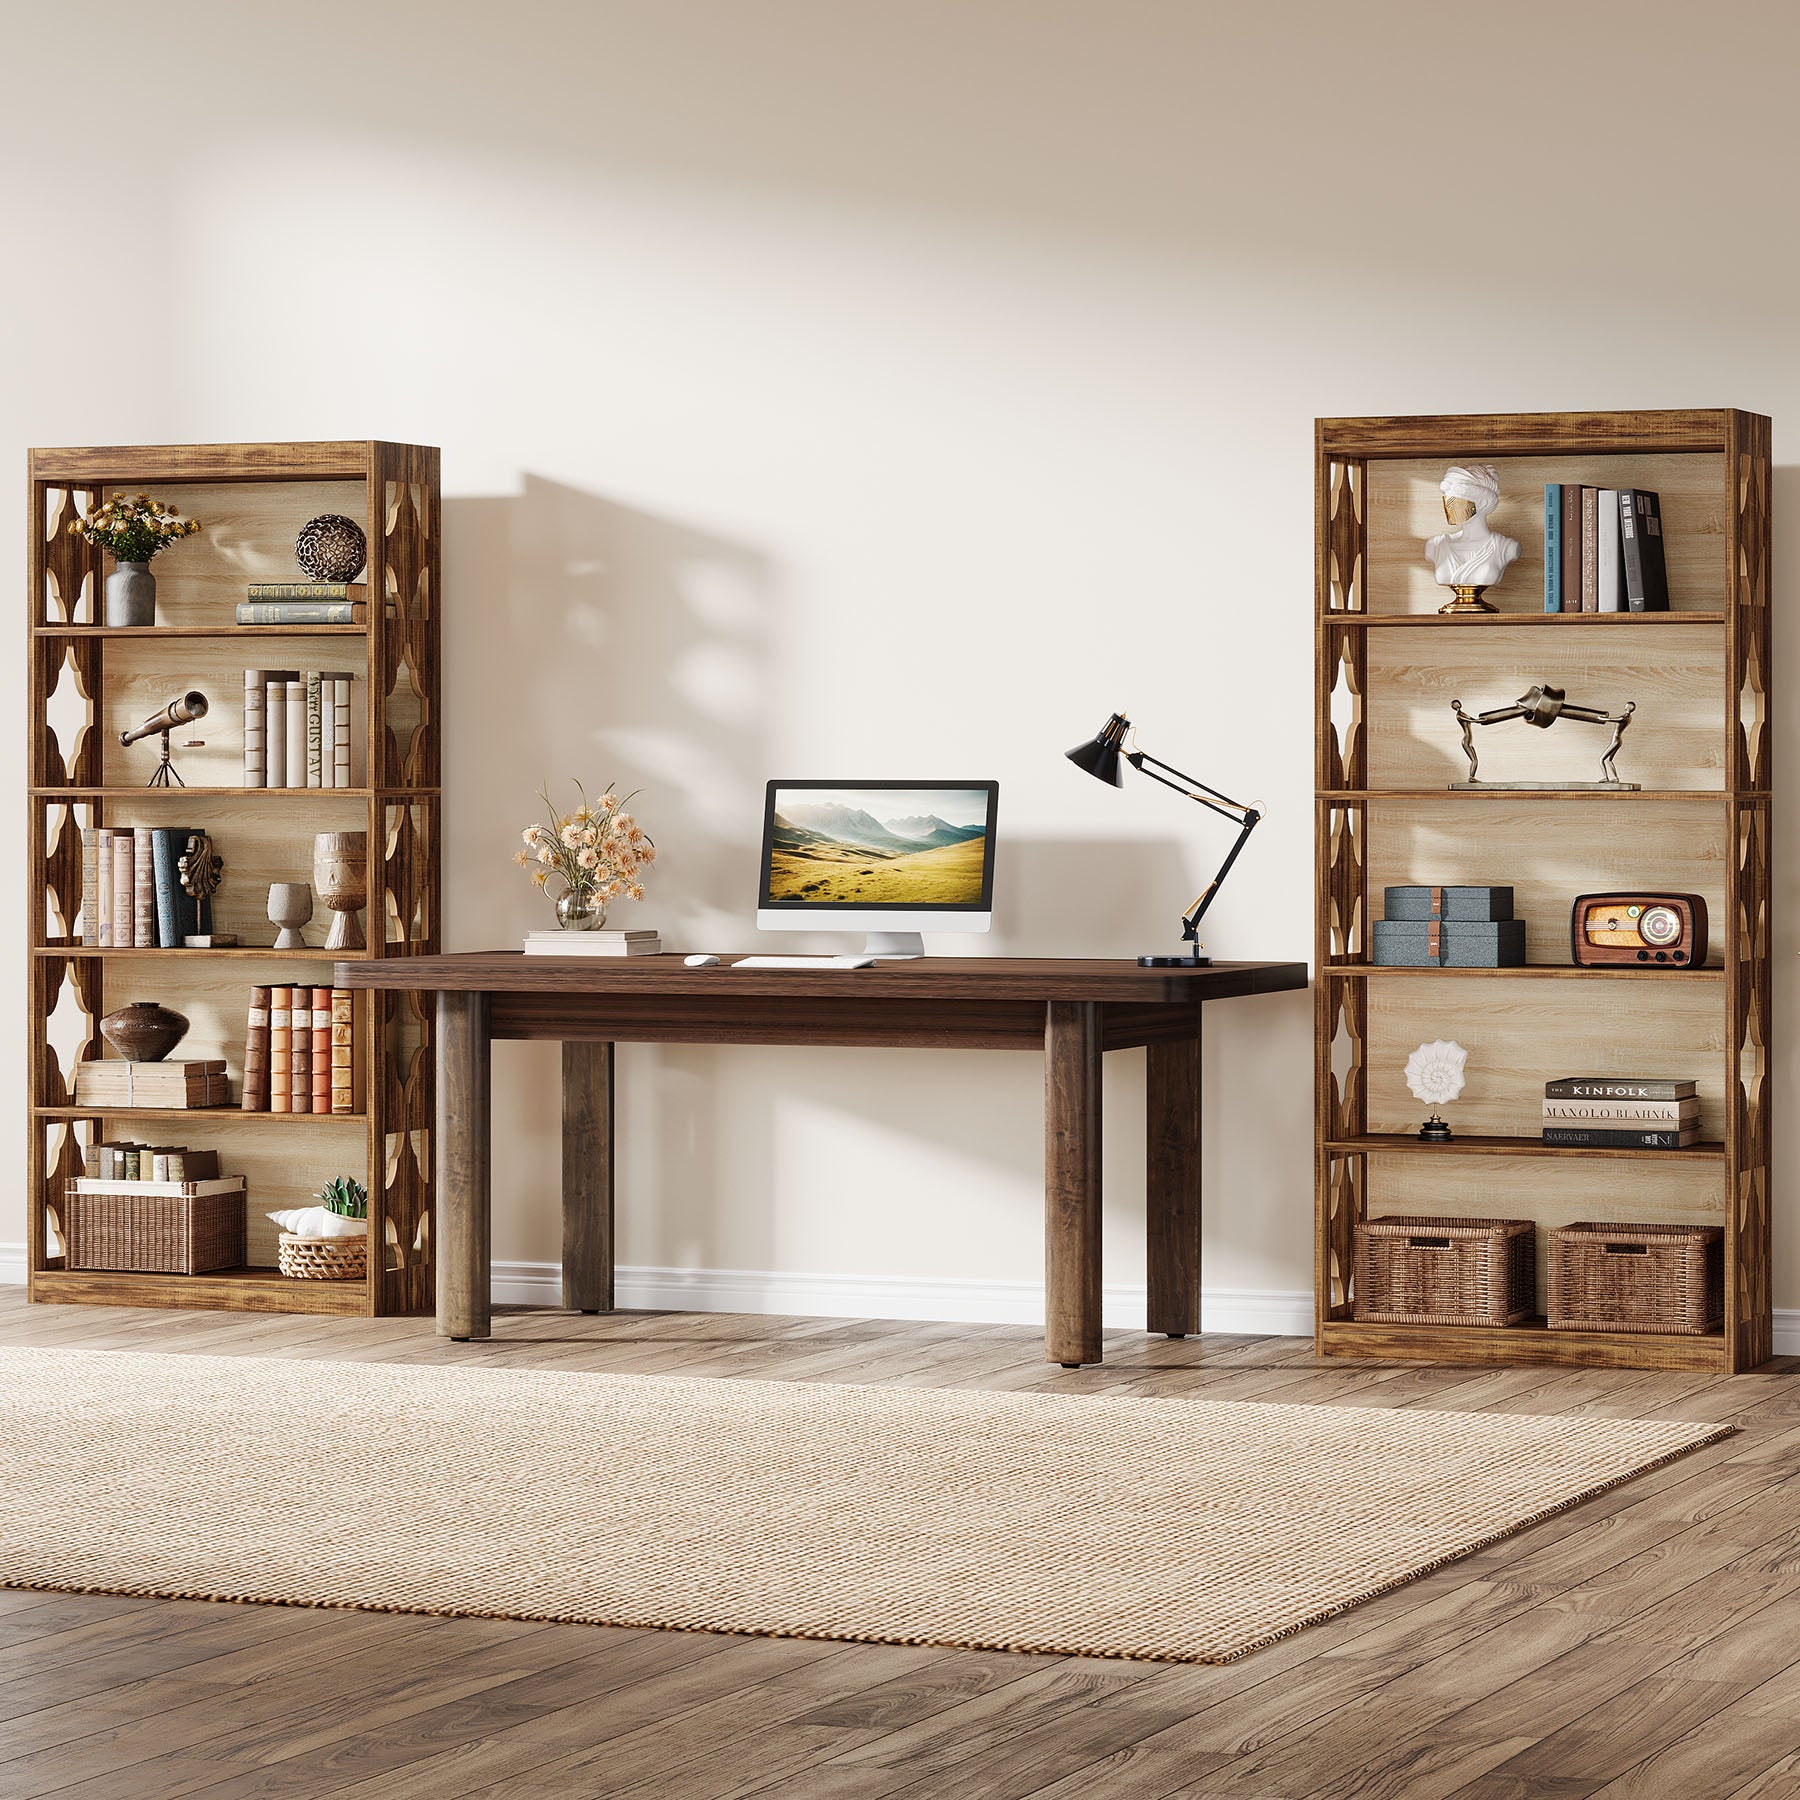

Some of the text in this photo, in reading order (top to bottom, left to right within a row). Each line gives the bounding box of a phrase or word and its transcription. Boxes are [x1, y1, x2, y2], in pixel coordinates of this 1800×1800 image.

[1622, 495, 1634, 539] NEW YORK INTERIORS
[309, 713, 321, 778] GUSTAV
[1573, 1086, 1648, 1097] KINFOLK
[1547, 1107, 1674, 1119] MANOLO BLAHNÍK
